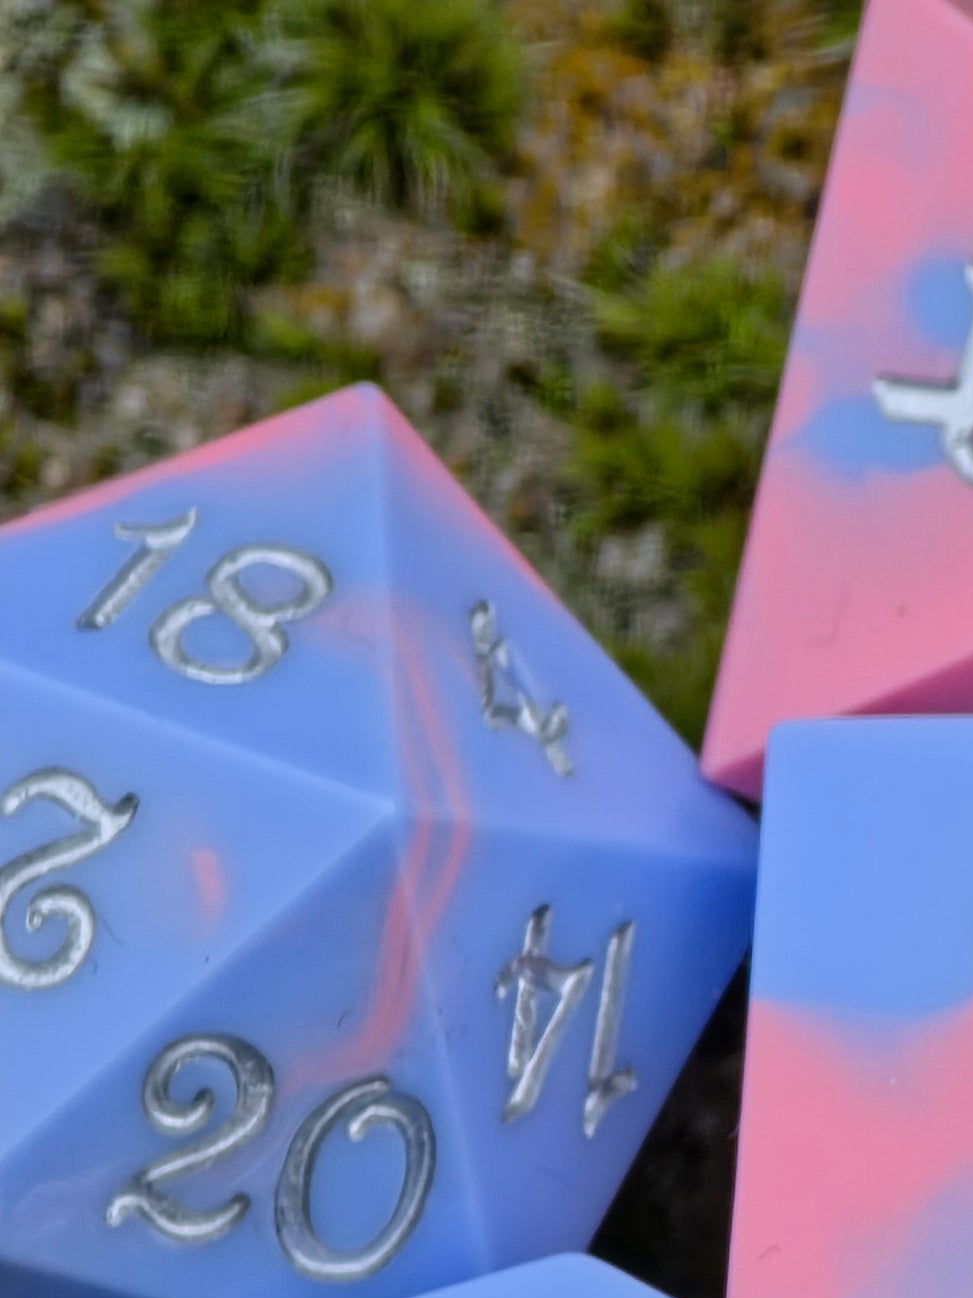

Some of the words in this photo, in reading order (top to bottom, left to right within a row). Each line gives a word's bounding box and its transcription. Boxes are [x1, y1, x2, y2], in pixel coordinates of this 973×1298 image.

[76, 508, 334, 685] 18
[470, 600, 575, 777] 4
[0, 767, 139, 990] 2
[494, 904, 638, 1138] 14
[105, 1033, 437, 1282] 20
